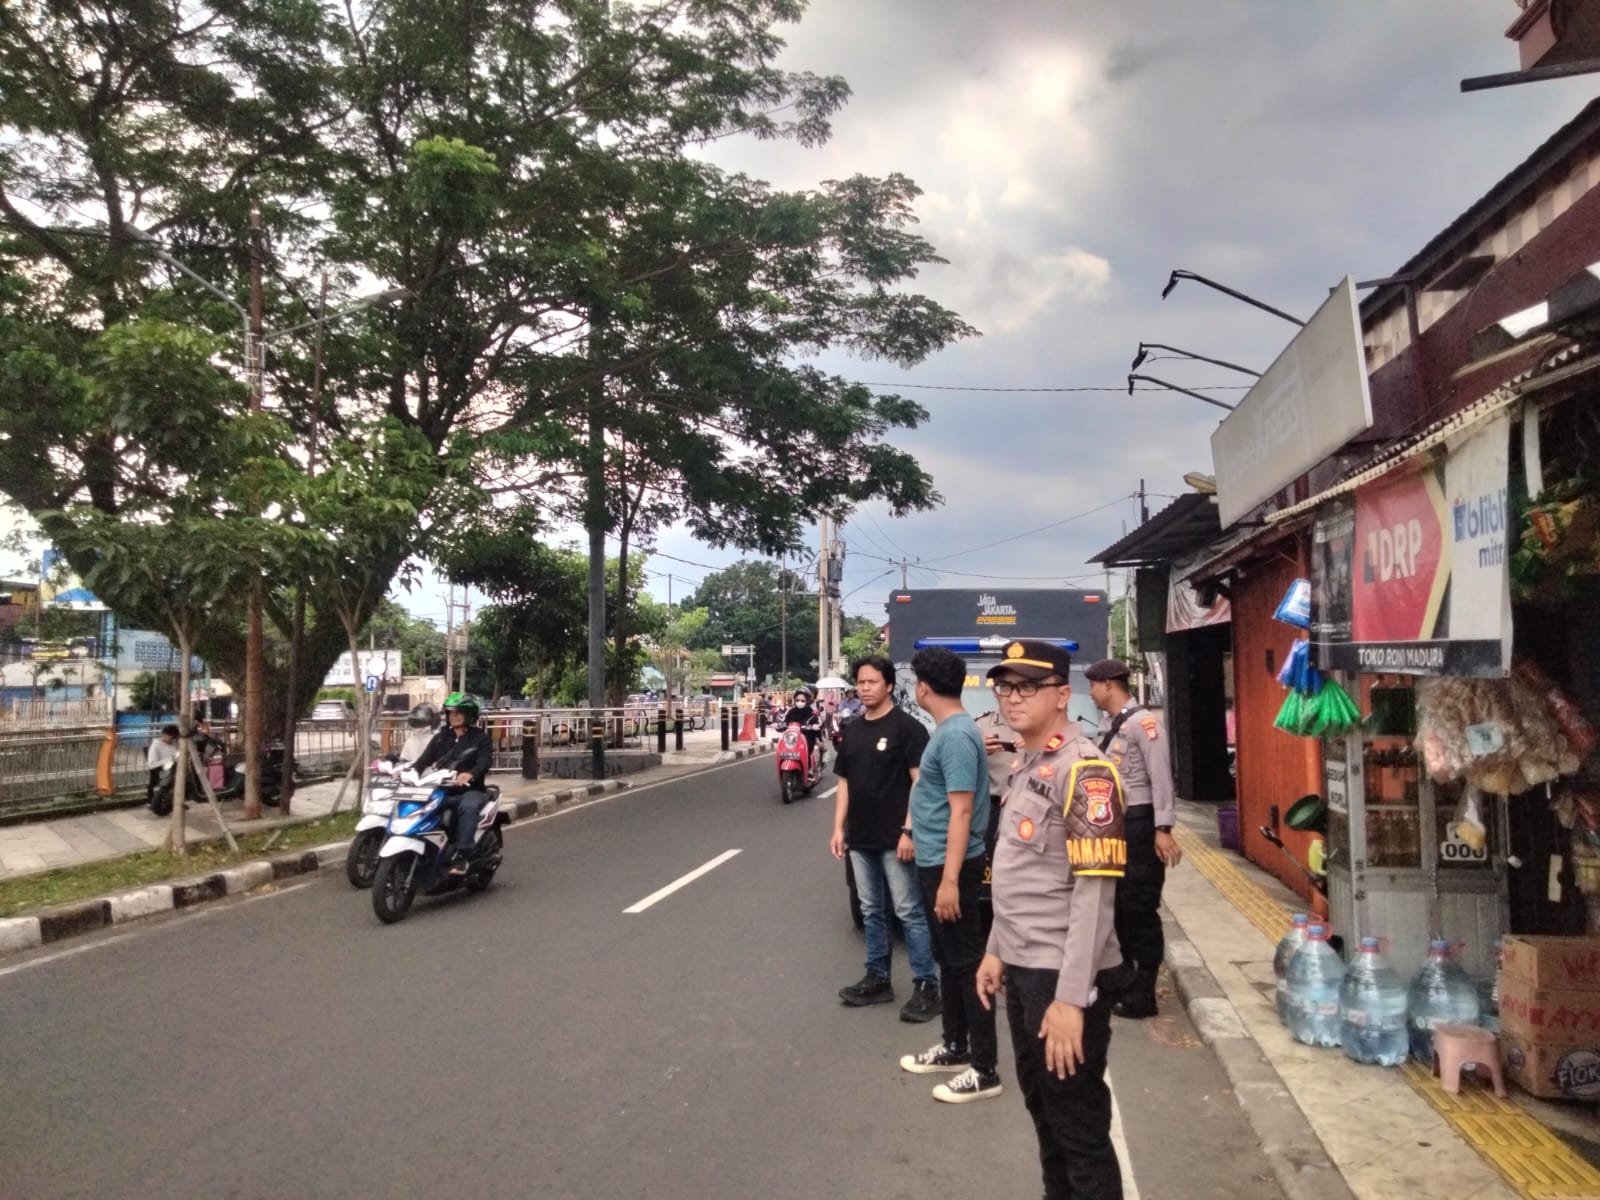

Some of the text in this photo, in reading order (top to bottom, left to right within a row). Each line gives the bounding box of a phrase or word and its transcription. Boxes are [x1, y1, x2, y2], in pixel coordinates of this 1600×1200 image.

[1358, 647, 1444, 667] TOKO RONI MADURA
